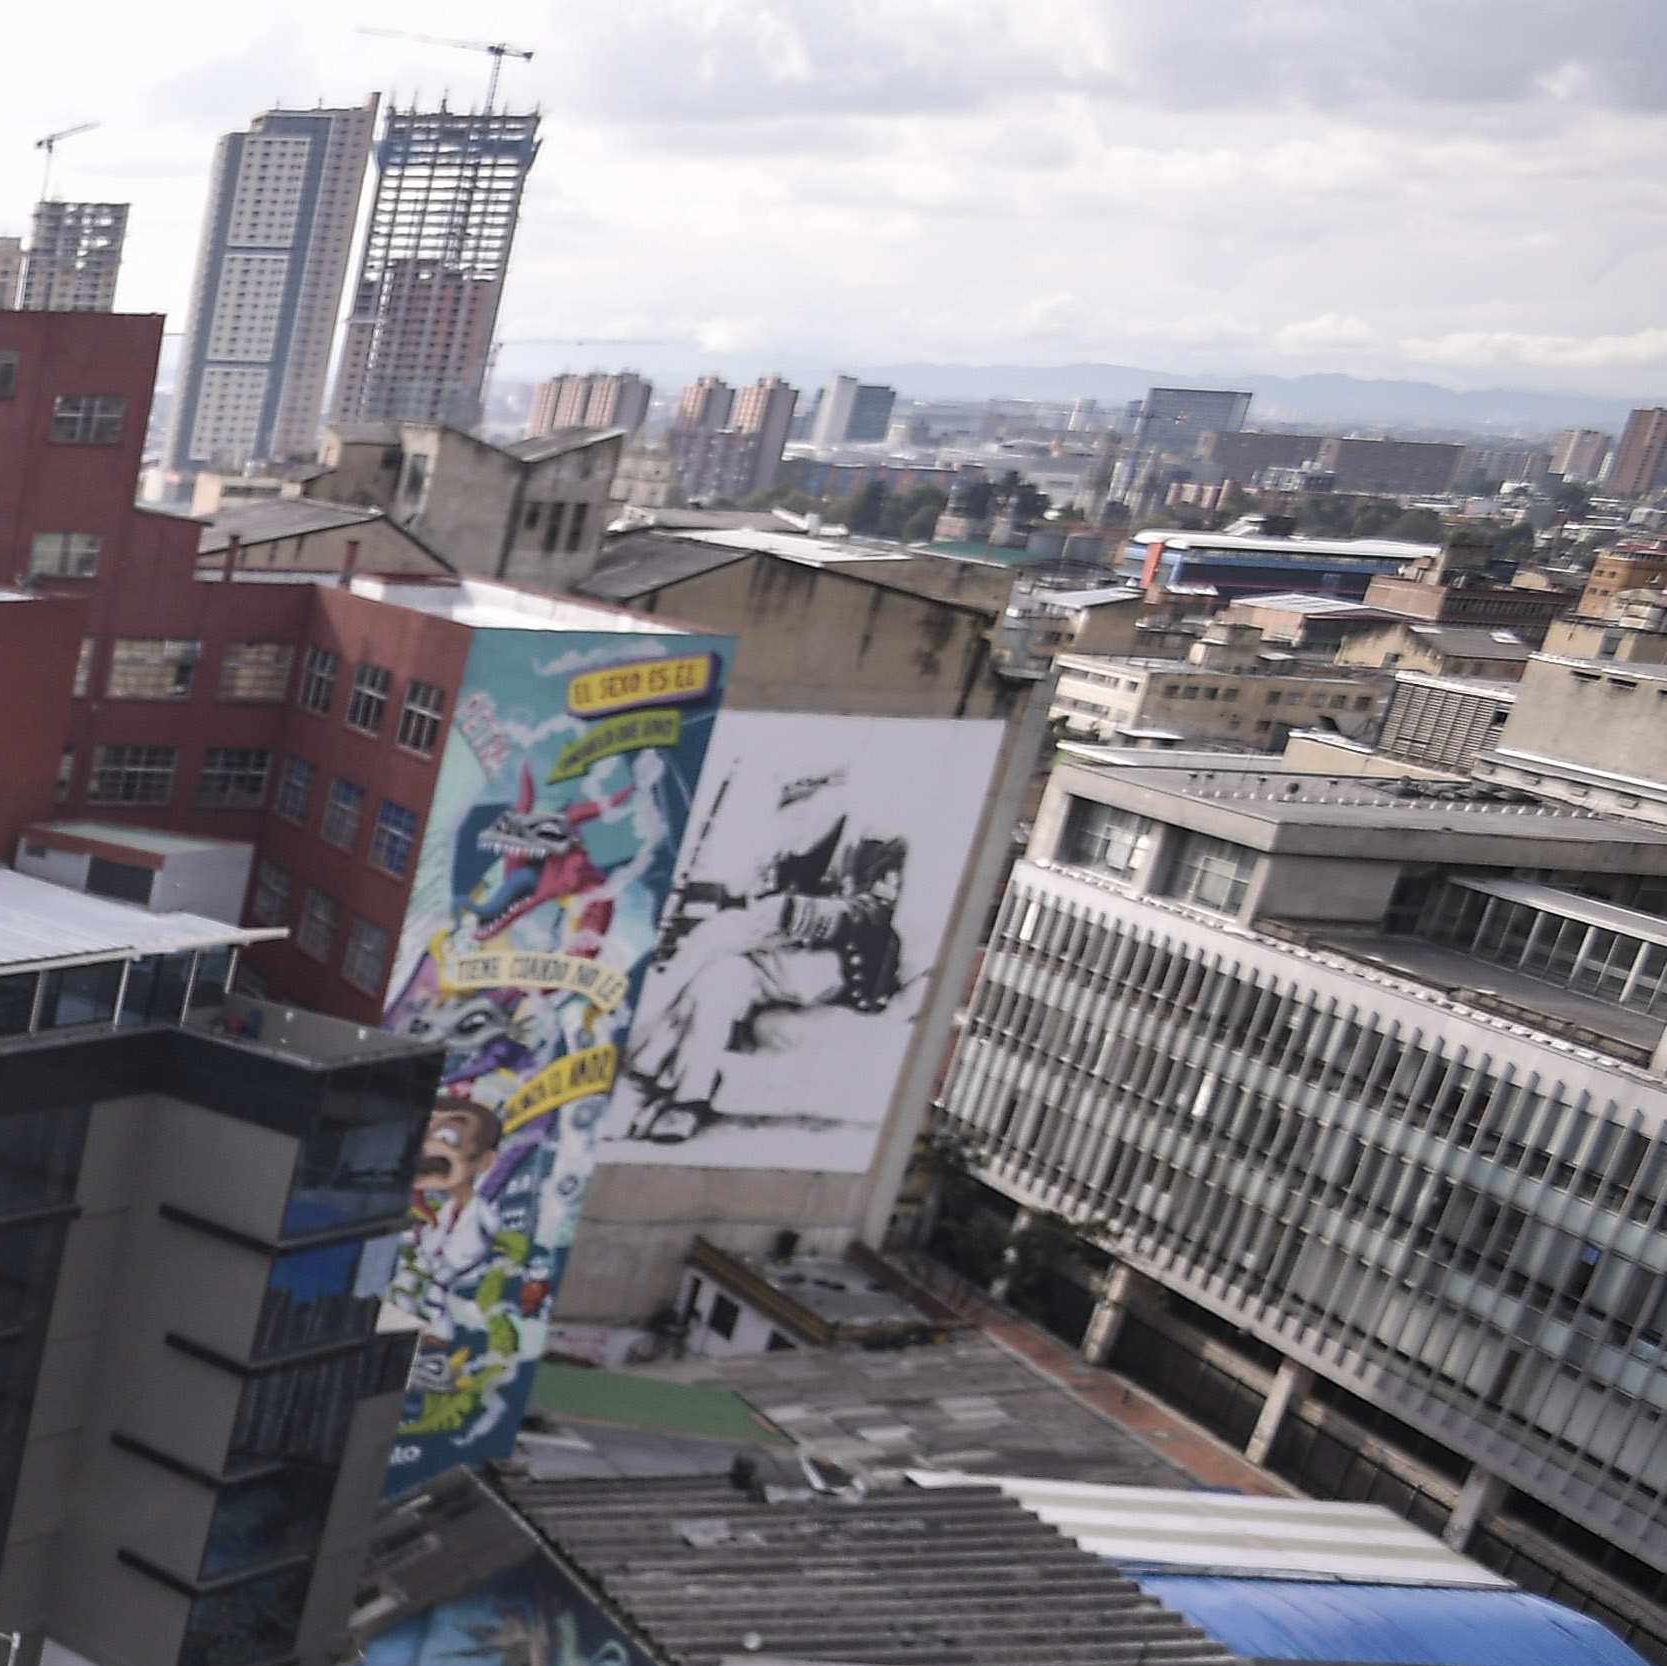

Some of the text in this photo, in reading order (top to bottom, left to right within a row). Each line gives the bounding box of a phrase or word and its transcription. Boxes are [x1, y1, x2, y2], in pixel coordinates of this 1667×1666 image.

[599, 672, 641, 700] SEXO
[648, 667, 668, 693] ES
[674, 663, 696, 688] EL
[458, 956, 501, 983] TIENE
[509, 956, 569, 982] CUANDO
